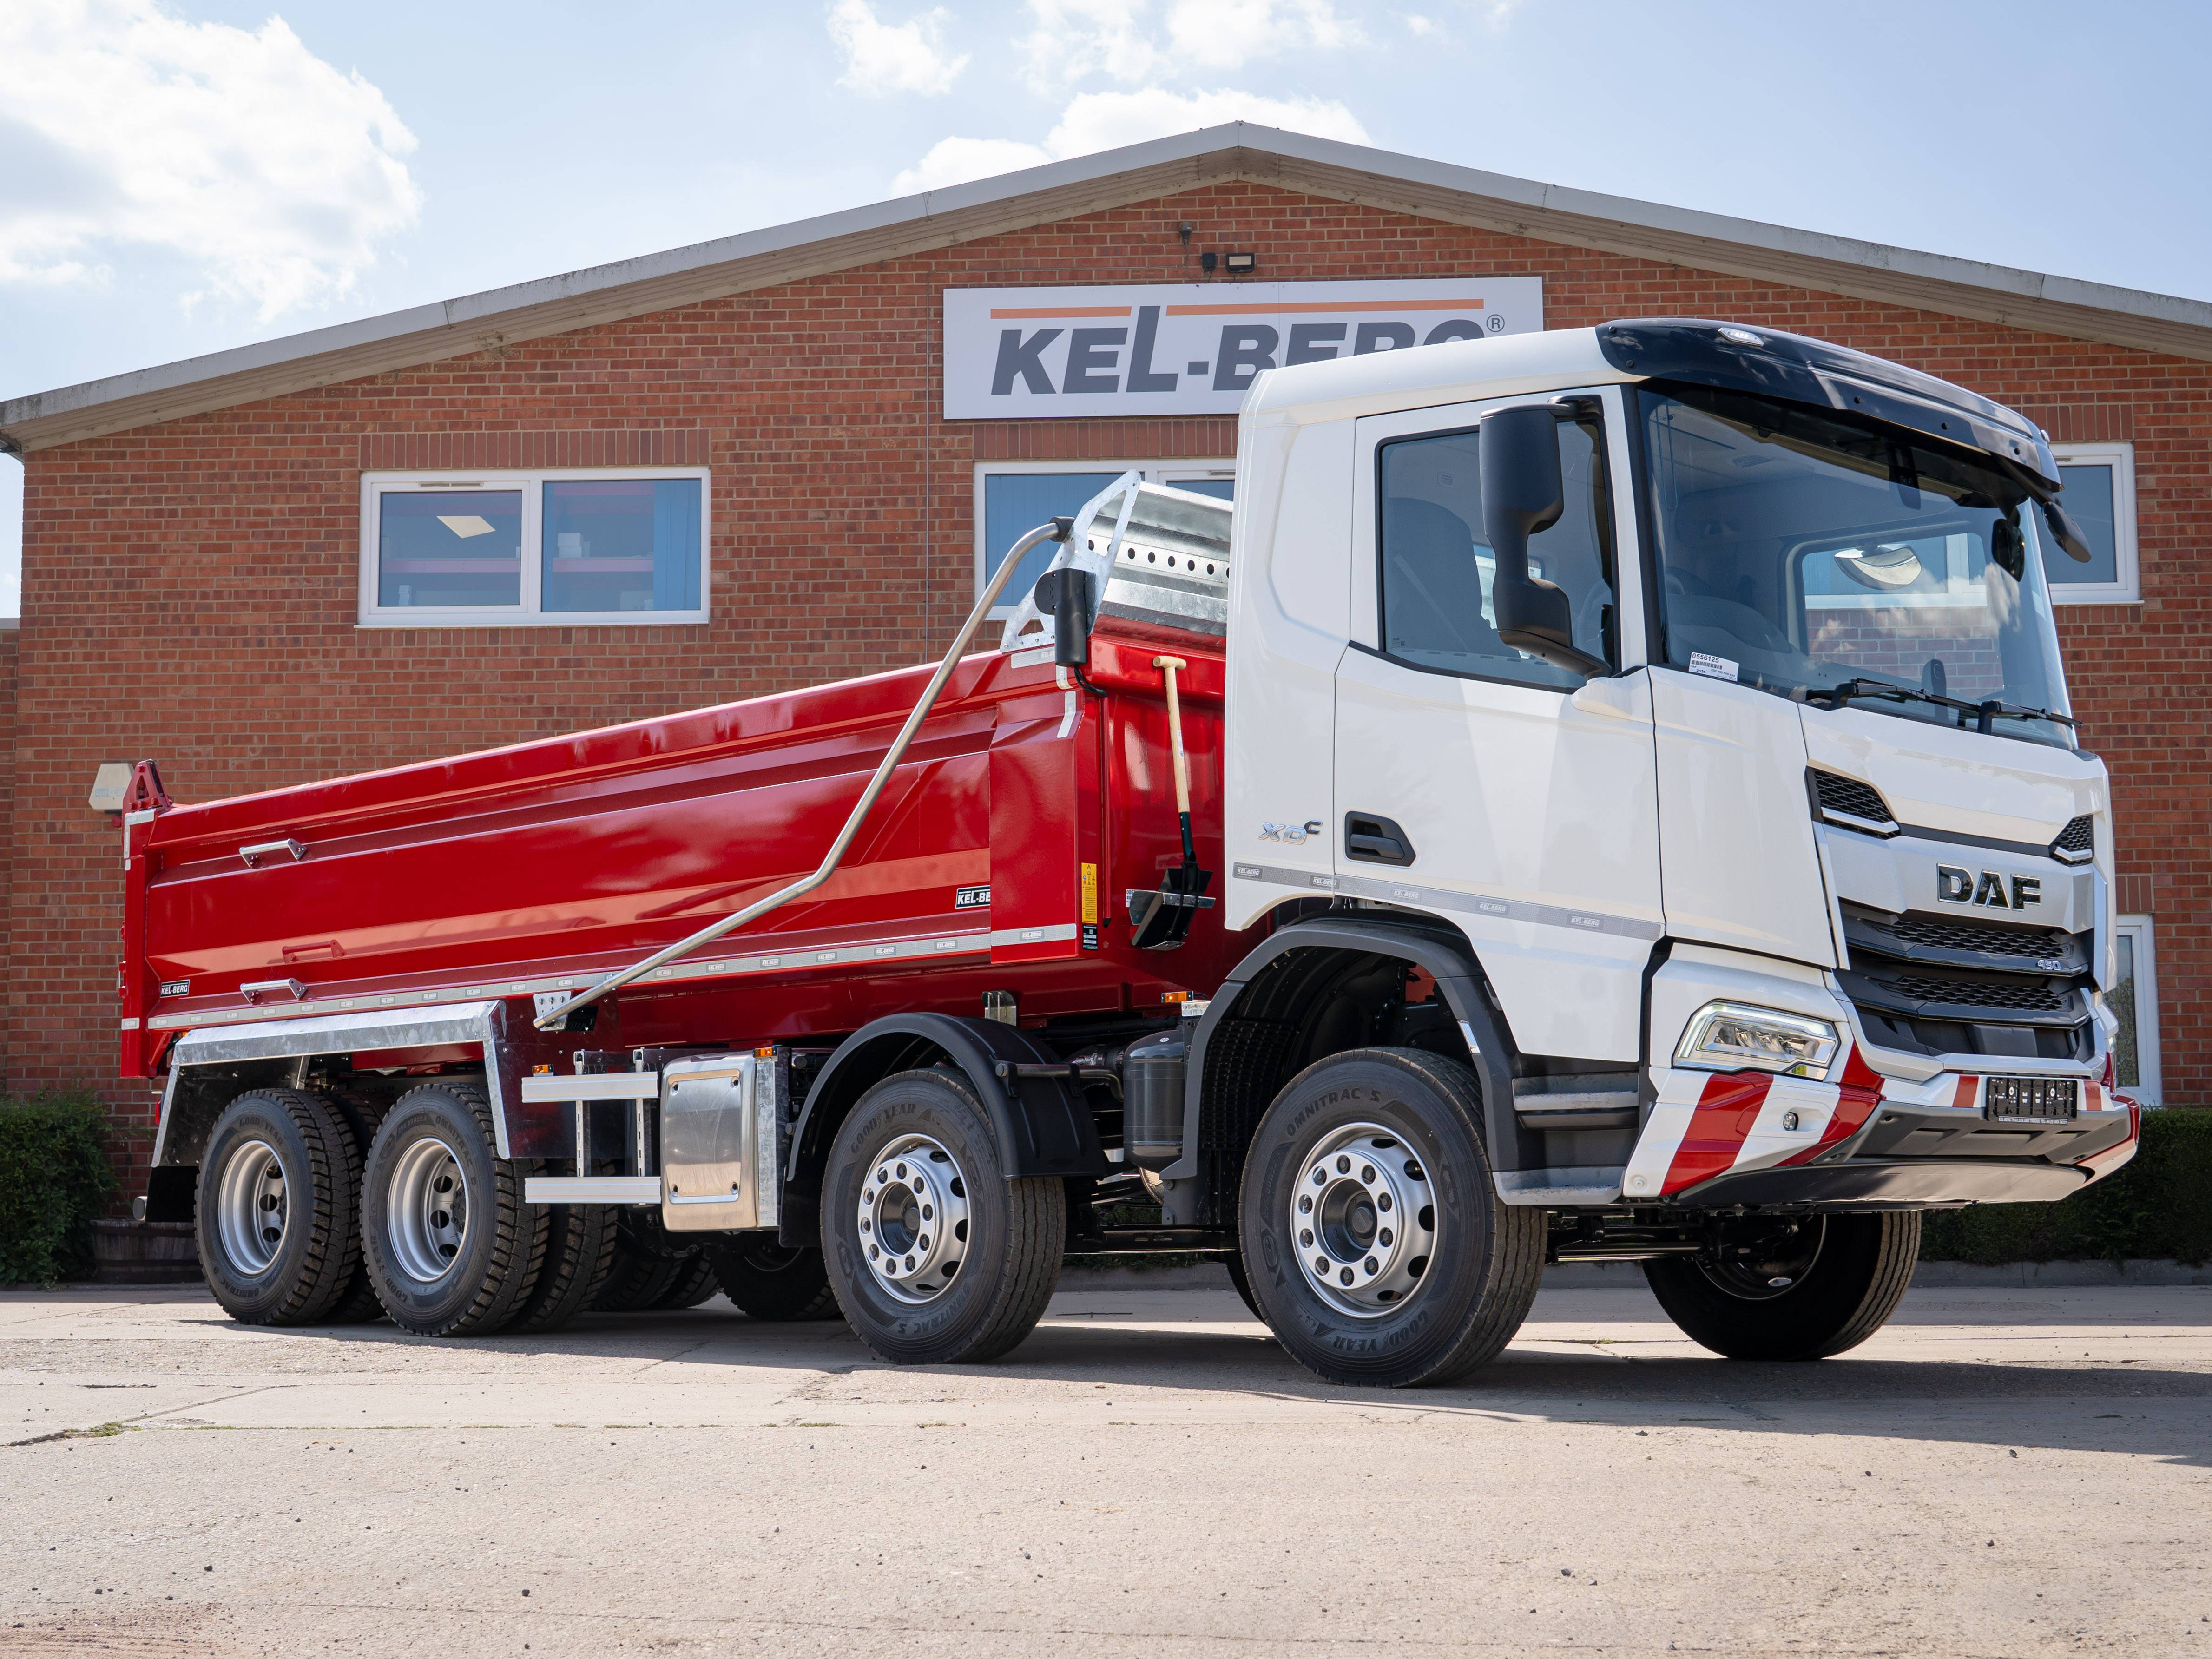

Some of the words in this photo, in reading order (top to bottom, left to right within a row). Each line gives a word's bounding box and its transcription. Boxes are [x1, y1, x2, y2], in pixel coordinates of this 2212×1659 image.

[1692, 653, 1719, 663] 0556125
[1936, 863, 2041, 912] DAF
[957, 890, 990, 905] KEL-BE
[1394, 889, 1419, 899] KEL-BERG
[1479, 902, 1506, 913] KEL-BERG
[1571, 916, 1600, 926] KEL-BERG
[2038, 959, 2061, 970] 450
[161, 982, 188, 994] KEL-BERG
[1287, 1088, 1361, 1136] OMNITRAC
[1369, 1089, 1381, 1102] S
[435, 1115, 473, 1167] OMNITRAC
[914, 1283, 970, 1334] OMNITRAC
